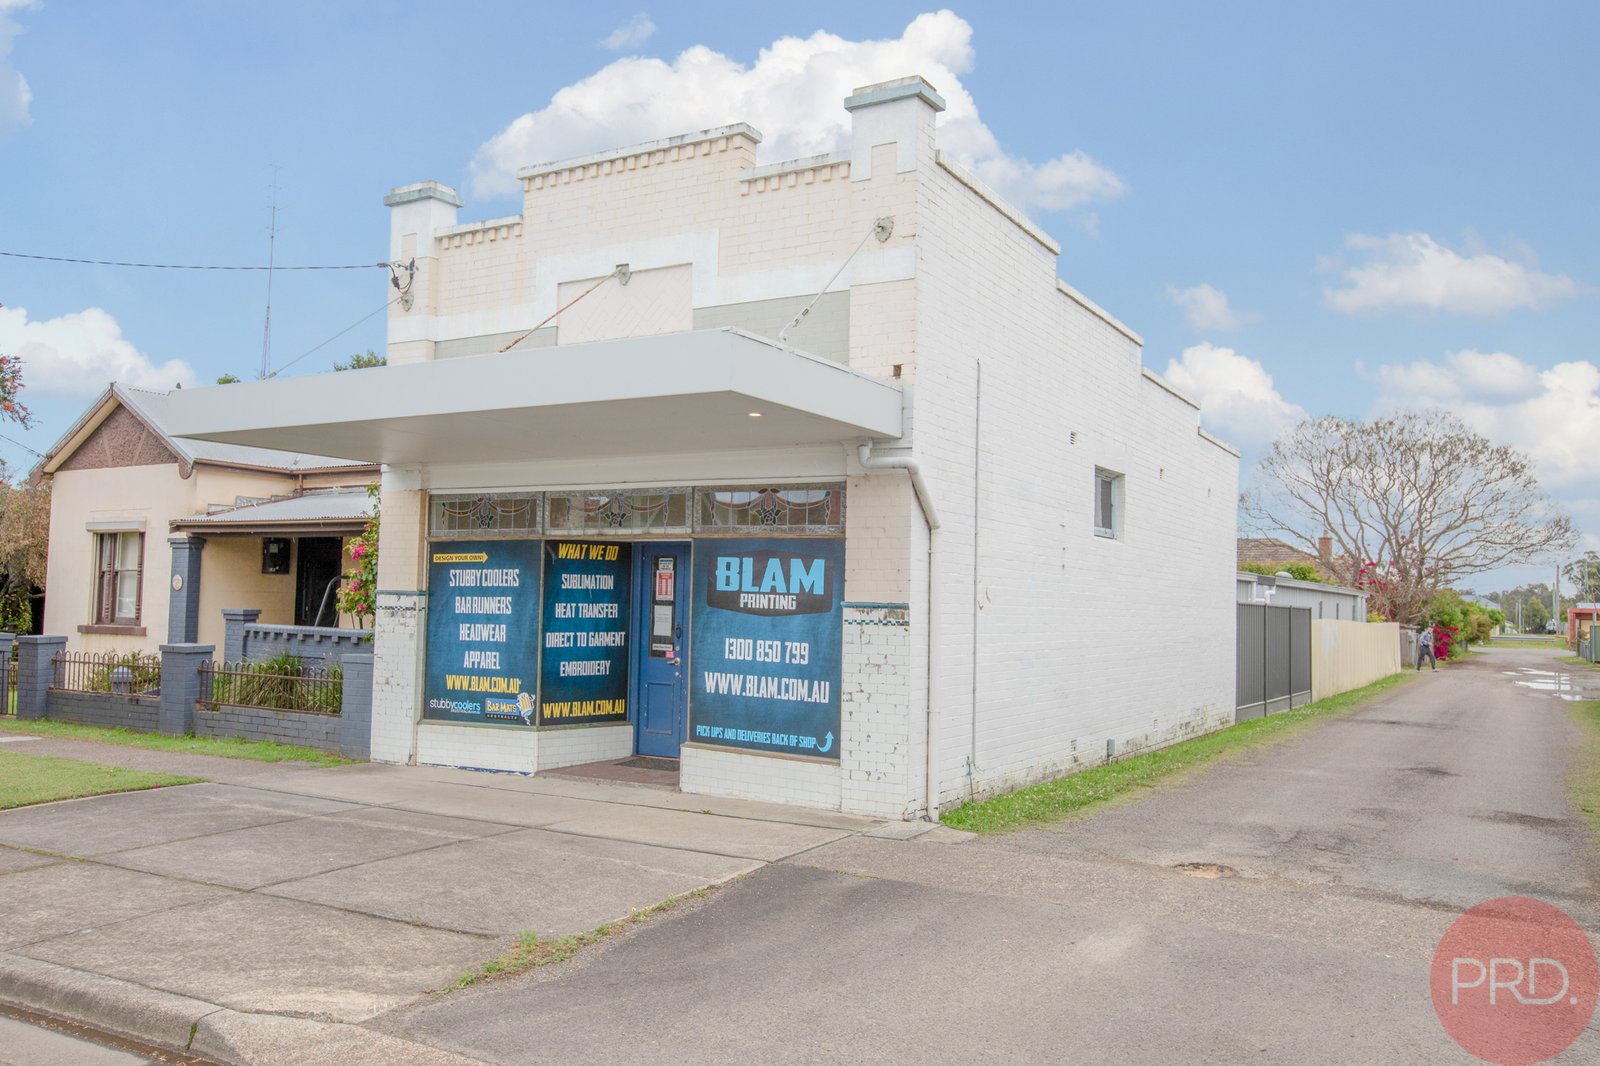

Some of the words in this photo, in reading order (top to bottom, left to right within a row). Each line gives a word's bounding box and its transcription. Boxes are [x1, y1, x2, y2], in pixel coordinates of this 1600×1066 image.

[558, 543, 587, 560] WHAT
[589, 545, 604, 560] WE
[605, 546, 619, 561] DO
[450, 570, 481, 586] STUBBY
[482, 569, 520, 586] COOLERS
[562, 574, 614, 590] SUBLIMATION
[716, 556, 826, 595] BLAM
[455, 597, 471, 614] BAR
[472, 597, 512, 614] RUNNERS
[555, 603, 576, 618] HEAT
[578, 603, 618, 618] TRANSFER
[740, 594, 796, 610] PRINTING
[460, 624, 506, 642] HEADWEAR
[546, 632, 574, 648] DIRECT
[577, 632, 587, 647] TO
[588, 632, 626, 646] GARMENT
[464, 651, 500, 669] APPAREL
[725, 638, 752, 661] 1300
[756, 640, 781, 663] 850
[785, 642, 808, 664] 799
[560, 660, 611, 676] EMBROIDERY
[446, 674, 520, 694] WWW.BLAM.COM.AU
[704, 672, 829, 704] WWW.BLAM.COM.AU
[430, 698, 480, 711] stubbycoolers
[543, 700, 625, 719] WWW.BLAM.COM.AU
[696, 725, 710, 737] PICK
[711, 727, 723, 738] UPS
[724, 728, 736, 740] AND
[737, 729, 771, 744] DELIVERIES
[772, 733, 788, 746] BACK
[789, 735, 798, 746] OF
[799, 737, 816, 748] SHOP
